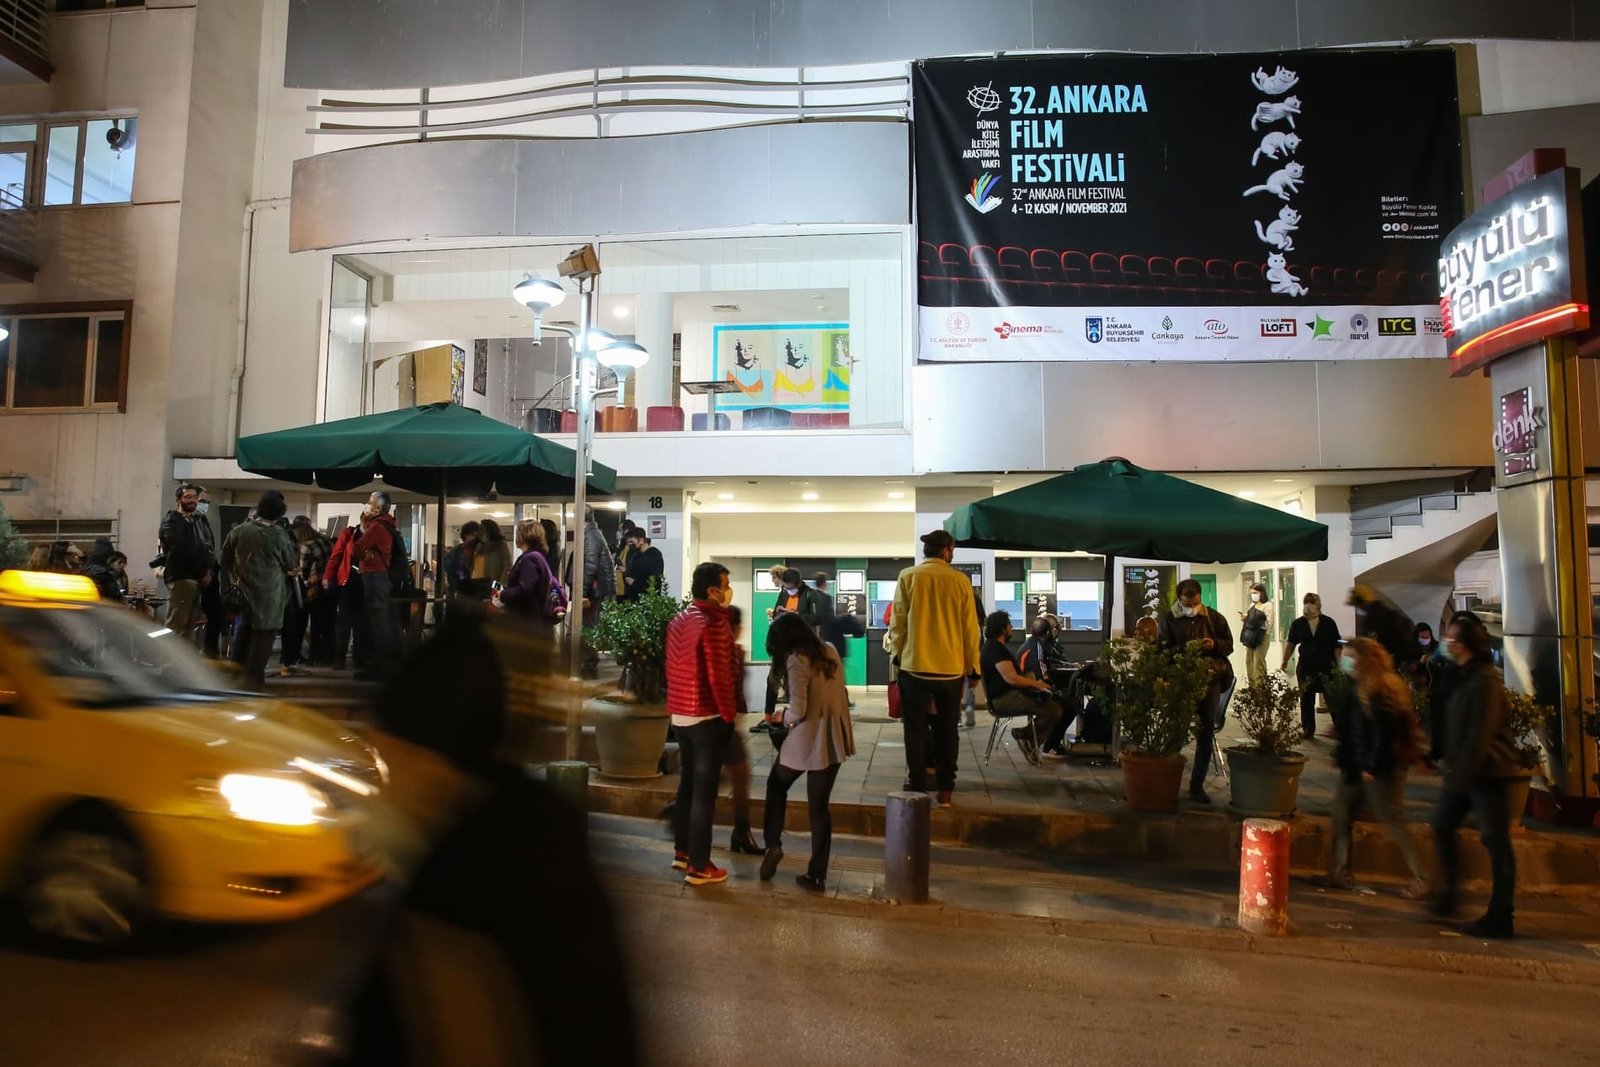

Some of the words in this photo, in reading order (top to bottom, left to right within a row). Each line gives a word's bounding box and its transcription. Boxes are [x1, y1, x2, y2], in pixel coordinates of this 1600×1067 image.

[1009, 86, 1044, 115] 32.
[1046, 85, 1148, 114] ANKARA
[976, 119, 999, 130] DÜNYA
[1028, 188, 1066, 200] ANKARA
[1067, 188, 1087, 200] FILM
[1088, 187, 1127, 200] FESTIVAL
[1011, 203, 1018, 214] 4
[1024, 203, 1033, 214] 12
[1034, 203, 1059, 214] KASIM
[1066, 203, 1108, 214] NOVEMBER
[1109, 202, 1127, 214] 2021
[1449, 256, 1557, 329] fener
[1266, 323, 1291, 332] LOFT
[648, 496, 663, 509] 18
